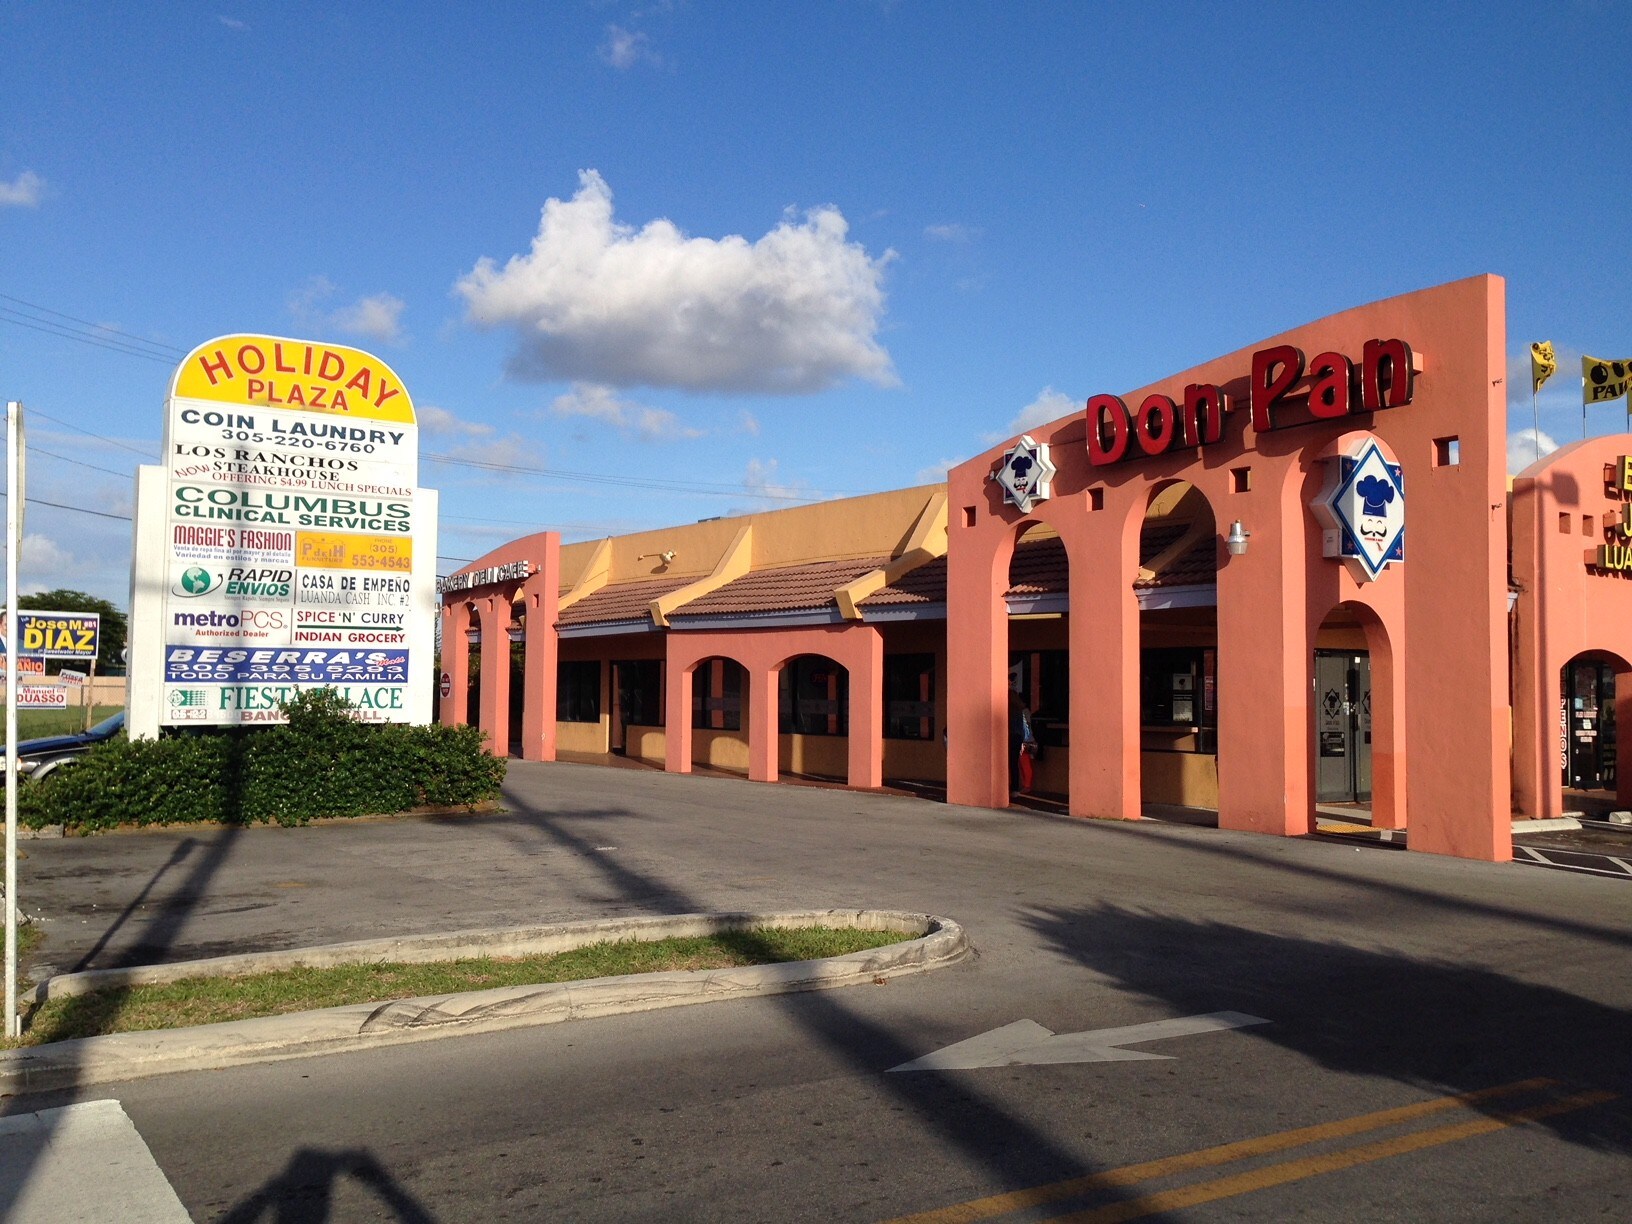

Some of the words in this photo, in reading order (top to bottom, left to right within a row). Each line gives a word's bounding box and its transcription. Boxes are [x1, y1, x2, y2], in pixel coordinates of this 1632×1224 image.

[199, 343, 400, 409] HOLIDAY
[247, 378, 349, 411] PLAZA
[1086, 383, 1225, 466] Don
[1250, 338, 1413, 433] Pan
[181, 409, 255, 430] COIN
[272, 418, 405, 446] LAUNDRY
[221, 428, 376, 454] 305-220-6760
[175, 443, 226, 459] LOS
[235, 450, 359, 472] RANCHOS
[174, 463, 211, 479] NOW
[212, 472, 278, 487] OFFERING
[279, 476, 308, 489] $4.99
[310, 479, 354, 493] LUNCH
[356, 483, 412, 497] SPECIALS
[212, 462, 340, 482] STEAKHOUSE
[174, 486, 411, 518] COLUMBUS
[174, 504, 291, 525] CLINICAL
[298, 513, 411, 532] SERVICES
[173, 525, 236, 548] MAGGIE'S
[240, 529, 292, 552] FASHION
[175, 551, 212, 559] Variedad
[225, 554, 252, 562] estilos
[260, 556, 289, 564] marcas
[369, 543, 398, 554] (305)
[351, 554, 411, 569] 553-4543
[227, 568, 293, 583] RAPID
[301, 574, 334, 590] CASA
[341, 576, 357, 591] DE
[363, 576, 411, 593] EMPEÑO
[436, 573, 472, 594] BAKERY
[498, 561, 529, 581] CAFE
[225, 581, 290, 597] ENVIOS
[300, 590, 341, 604] LUANDA
[345, 592, 370, 606] CASH
[377, 593, 396, 606] INC.
[399, 594, 410, 606] #2
[25, 617, 68, 630] Jose
[69, 619, 86, 630] M.
[173, 609, 284, 629] metroPCS
[297, 610, 335, 623] SPICE
[361, 612, 405, 625] CURRY
[23, 628, 95, 651] DIAZ
[195, 628, 240, 638] Authorized
[242, 630, 269, 638] Dealer
[295, 631, 342, 642] INDIAN
[348, 632, 406, 643] GROCERY
[168, 649, 387, 665] BESERRA'S
[168, 671, 229, 680] TODO
[237, 672, 292, 680] PARA
[297, 672, 324, 680] SU
[331, 672, 405, 681] FAMILIA
[169, 663, 235, 672] 305
[250, 664, 312, 673] 395
[326, 664, 404, 674] 5293
